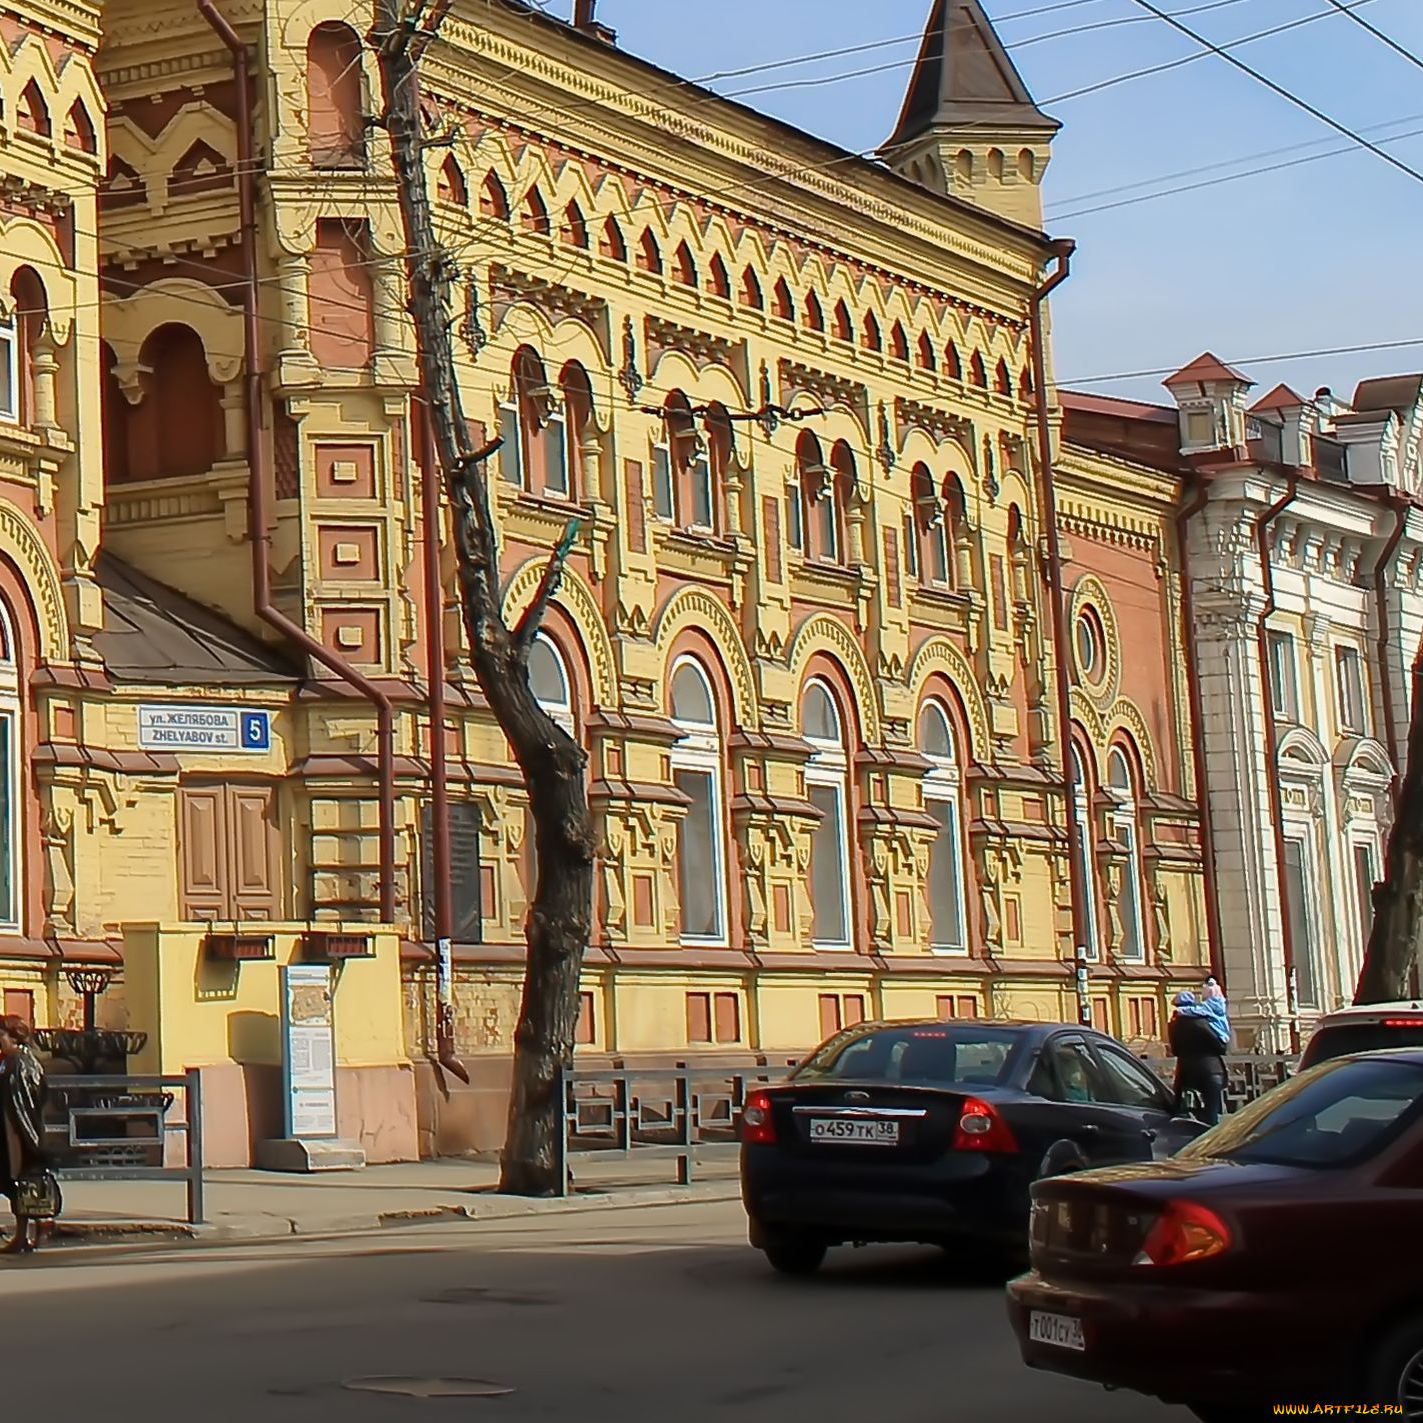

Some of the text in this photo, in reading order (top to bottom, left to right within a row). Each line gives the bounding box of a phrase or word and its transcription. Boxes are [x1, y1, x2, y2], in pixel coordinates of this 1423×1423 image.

[149, 713, 229, 726] ул. ЖЕЛЯБОВА
[152, 729, 228, 743] ZHELYABOV st.
[249, 719, 262, 741] 5
